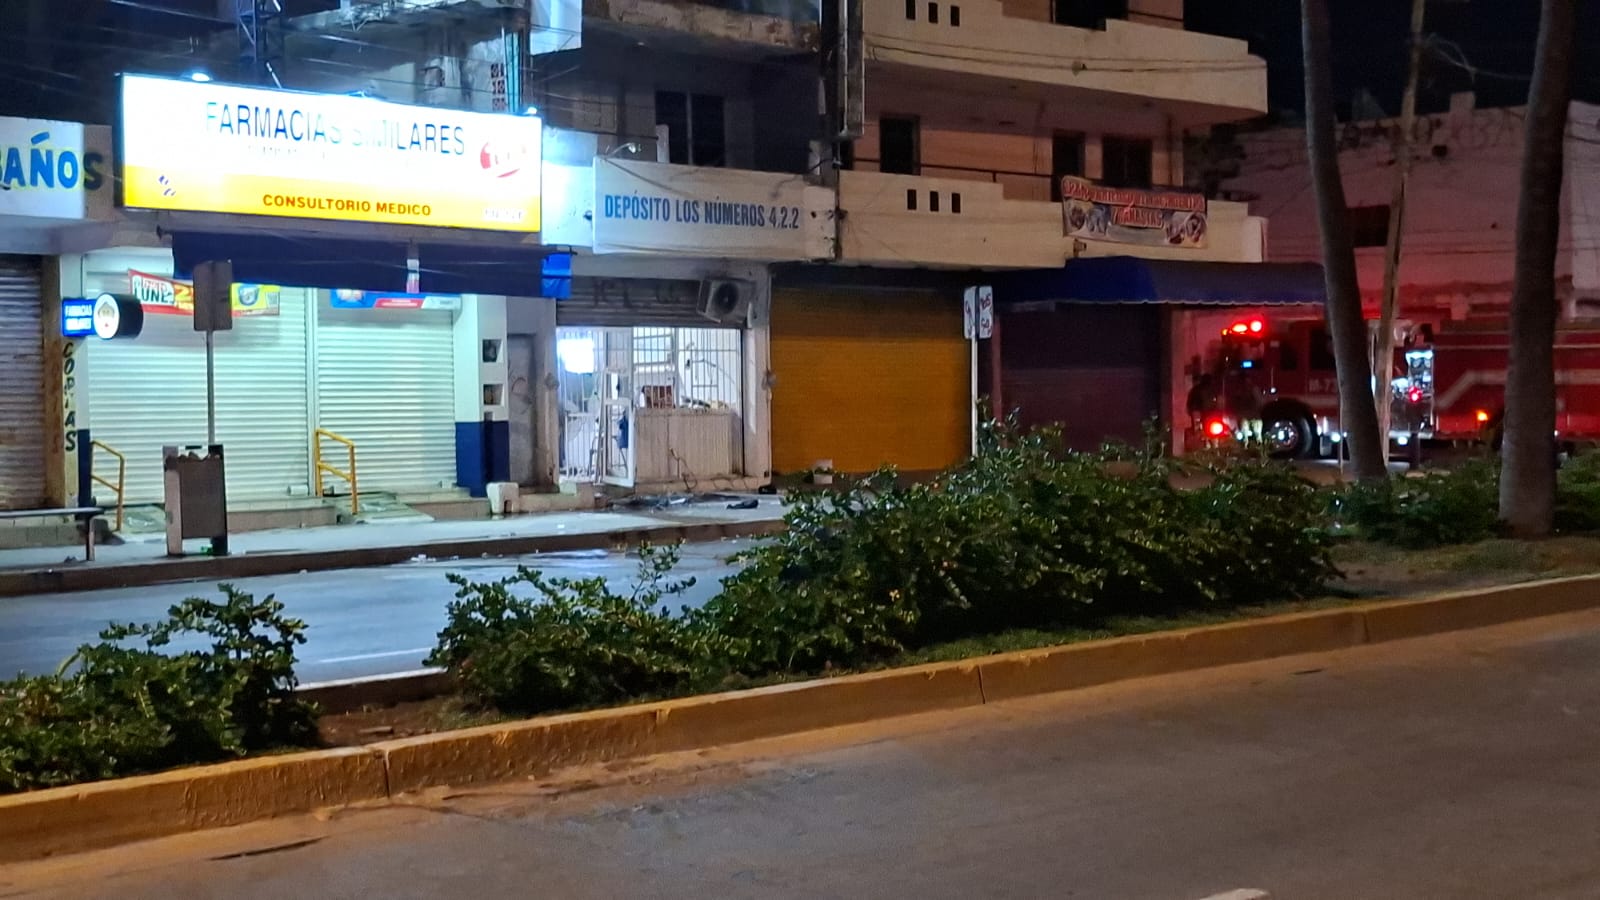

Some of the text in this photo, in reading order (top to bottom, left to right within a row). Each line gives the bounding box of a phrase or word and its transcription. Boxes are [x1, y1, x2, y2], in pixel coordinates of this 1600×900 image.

[0, 132, 104, 190] AÑOS
[263, 194, 431, 216] CONSULTORIO MEDICO
[604, 190, 670, 222] DEPÓSITO
[676, 200, 699, 223] LOS
[704, 196, 765, 227] NÚMEROS
